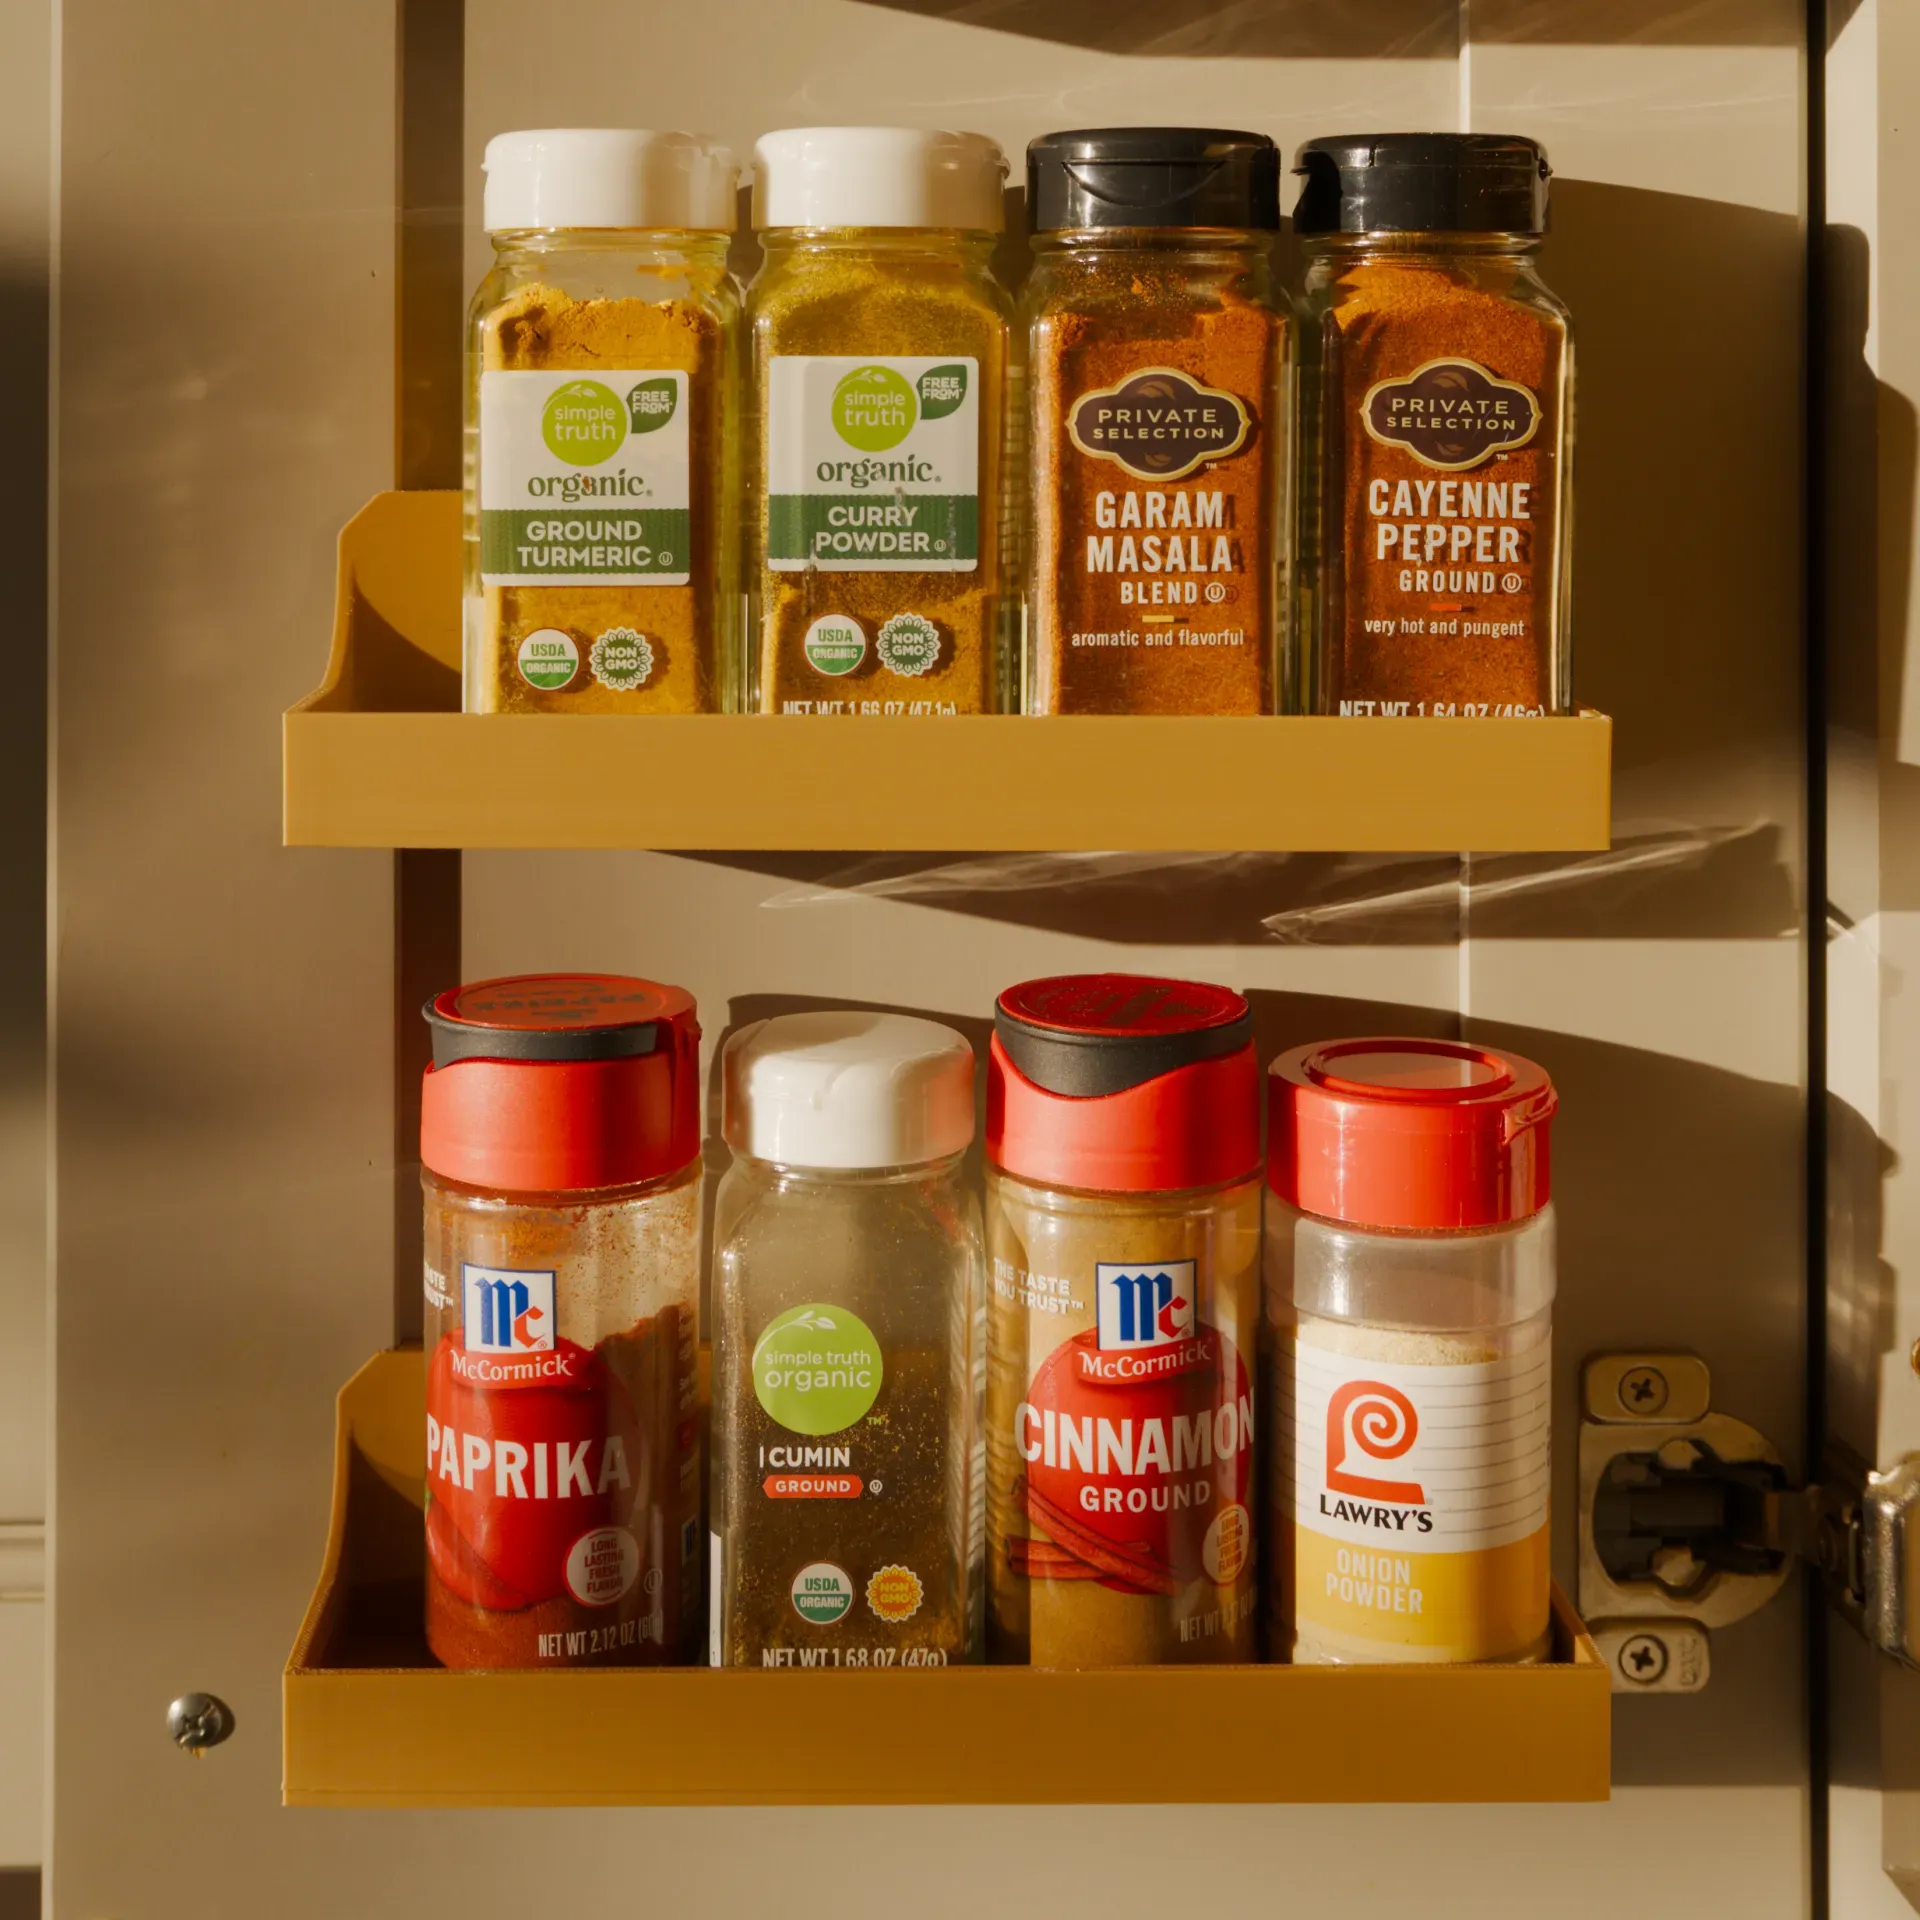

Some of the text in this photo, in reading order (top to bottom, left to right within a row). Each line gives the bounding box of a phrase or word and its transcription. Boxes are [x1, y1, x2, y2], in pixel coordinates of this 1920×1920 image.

[922, 377, 959, 389] FREE
[632, 391, 670, 402] FREE
[844, 391, 905, 408] simple
[1392, 398, 1509, 415] PRIVATE
[555, 405, 616, 423] simple
[845, 408, 906, 427] truth
[1098, 408, 1217, 424] PRIVATE
[1387, 417, 1516, 431] SELECTION
[555, 423, 616, 441] truth
[1093, 428, 1224, 439] SELECTION
[816, 454, 933, 488] organic
[527, 468, 644, 503] organic
[1369, 479, 1531, 520] CAYENNE
[827, 506, 919, 527] CURRY
[1095, 491, 1223, 529] GARAM
[526, 521, 642, 541] GROUND
[815, 532, 930, 552] POWDER
[1377, 523, 1520, 563] PEPPER
[517, 546, 651, 567] TURMERIC
[1087, 535, 1233, 573] MASALA
[1400, 570, 1496, 594] GROUND
[1120, 581, 1198, 605] BLEND
[818, 628, 853, 643] USDA
[1071, 629, 1244, 647] aromatic and flavorful
[1364, 617, 1524, 639] very hot and pungent
[892, 633, 924, 644] NON
[531, 643, 566, 657] USDA
[605, 647, 637, 658] NON
[812, 648, 858, 659] ORGANIC
[526, 662, 571, 674] ORGANIC
[1018, 1268, 1071, 1296] TASTE
[450, 1349, 573, 1381] McCormick
[765, 1350, 871, 1367] simple truth
[1077, 1340, 1211, 1378] McCormick
[765, 1367, 871, 1391] organic
[1014, 1386, 1254, 1476] CINNAMON
[427, 1412, 631, 1500] PAPRIKA
[769, 1446, 850, 1468] CUMIN
[775, 1480, 851, 1493] GROUND
[1079, 1480, 1211, 1512] GROUND
[1320, 1494, 1433, 1533] LAWRY'S
[1337, 1548, 1410, 1586] ONION
[805, 1578, 840, 1592] USDA
[880, 1582, 910, 1593] NON
[1326, 1572, 1423, 1614] POWDER
[800, 1596, 844, 1609] ORGANIC
[538, 1633, 563, 1658] NET
[565, 1631, 587, 1656] WT
[590, 1625, 617, 1653] 2.12
[620, 1620, 635, 1646] OZ
[799, 1648, 828, 1667] WT
